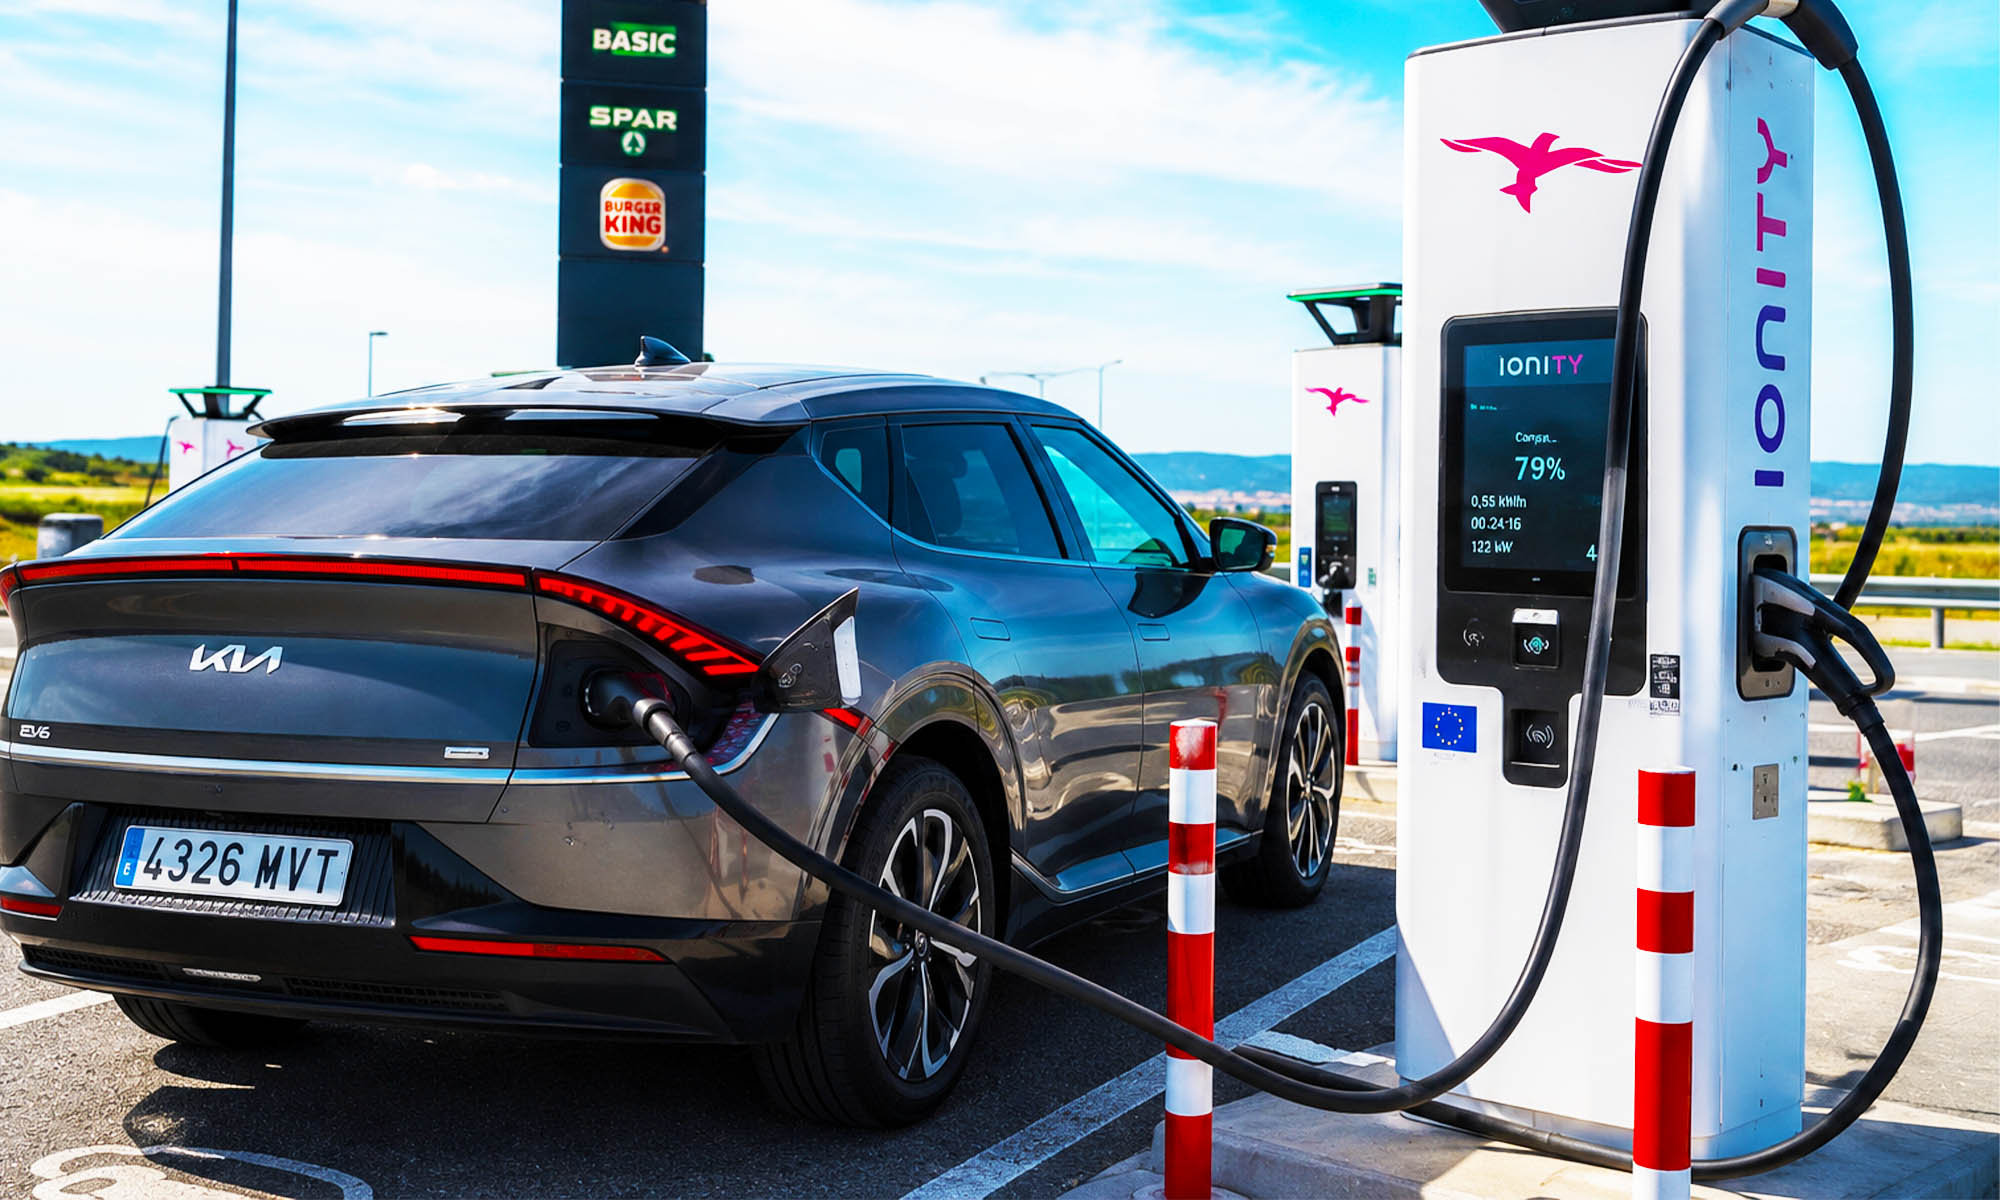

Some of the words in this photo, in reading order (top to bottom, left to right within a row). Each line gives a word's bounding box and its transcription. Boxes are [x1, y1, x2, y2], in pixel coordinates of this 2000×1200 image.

[593, 28, 676, 54] BASIC
[590, 106, 677, 130] SPAR
[605, 200, 661, 215] BURGER
[605, 215, 662, 235] KING
[1754, 116, 1788, 488] IONITY
[1499, 354, 1584, 376] IONITY
[1515, 456, 1566, 481] 79%
[1471, 540, 1492, 553] 122
[1494, 540, 1514, 553] kW
[189, 643, 283, 674] KIA
[19, 724, 51, 740] EV6
[143, 836, 244, 886] 4326
[254, 844, 339, 894] MVT
